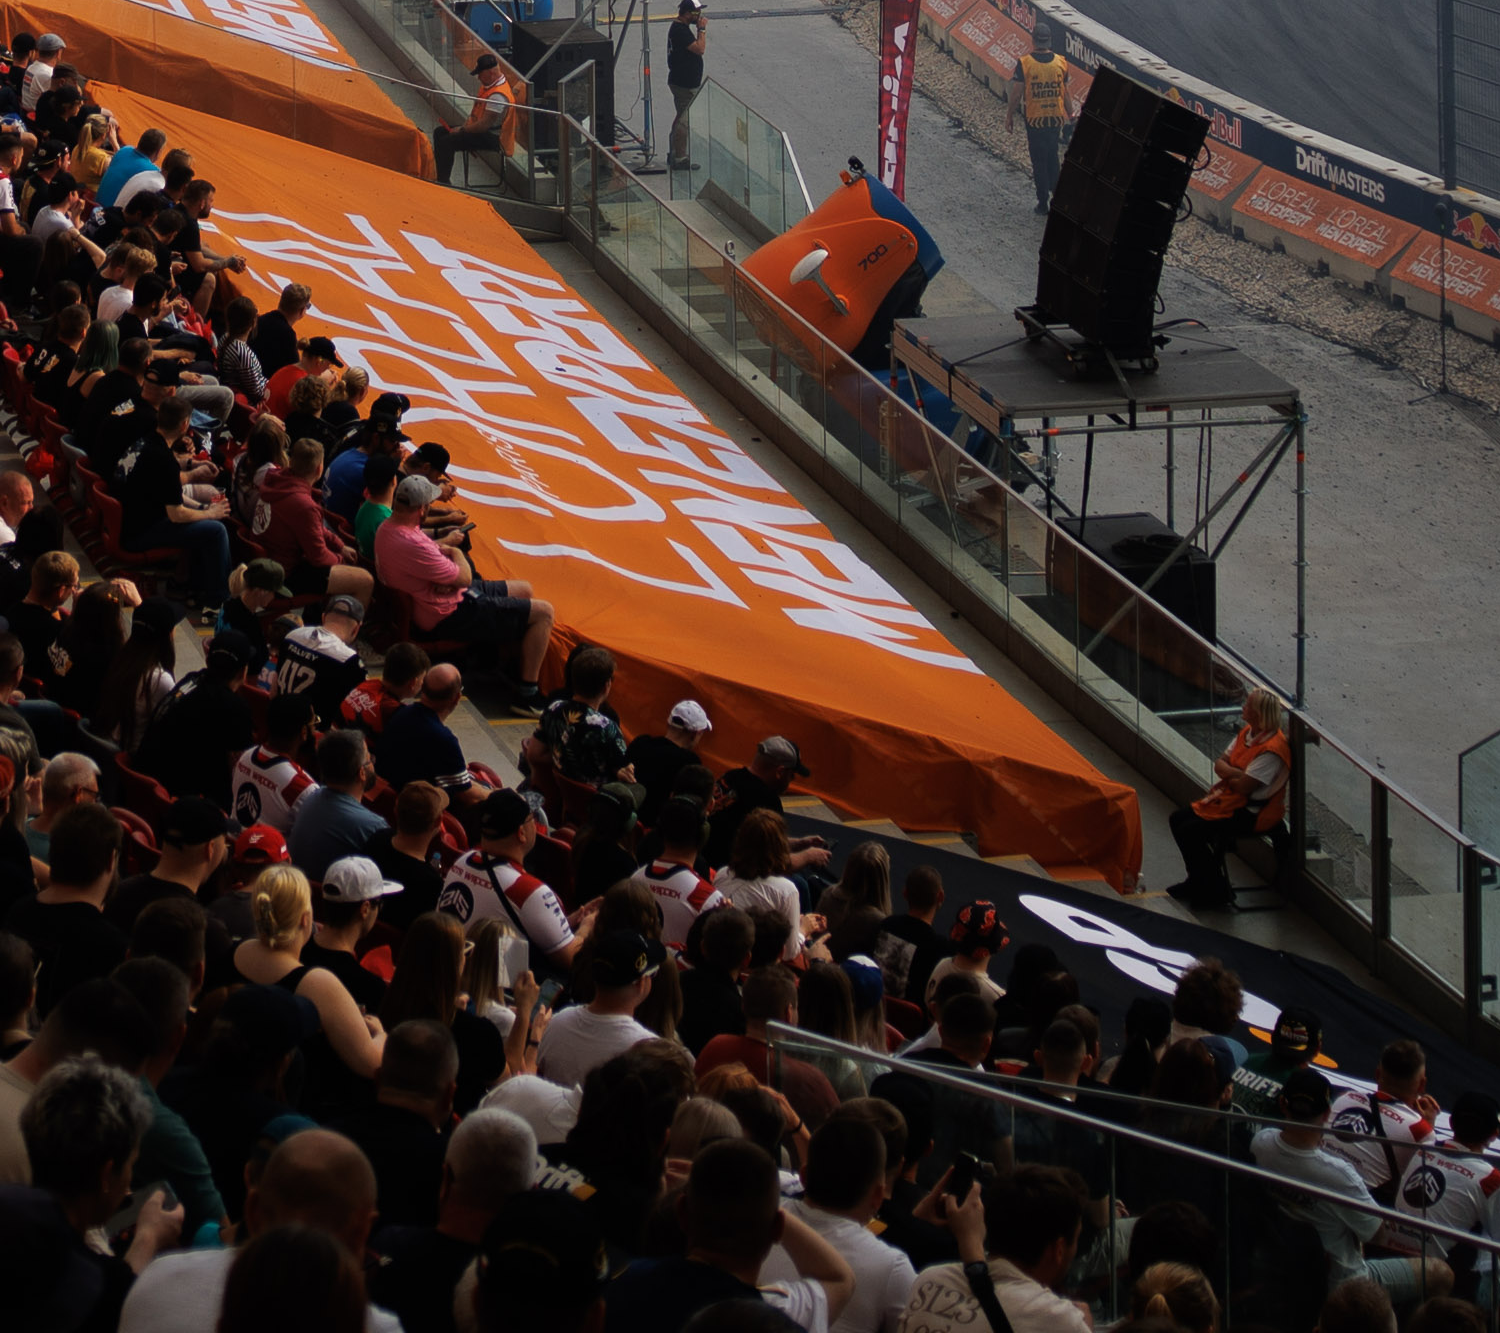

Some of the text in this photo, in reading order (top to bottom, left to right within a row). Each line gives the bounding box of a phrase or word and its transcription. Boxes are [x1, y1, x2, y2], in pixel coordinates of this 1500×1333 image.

[858, 243, 889, 272] 700
[401, 231, 984, 676] MEN EXPERT
[278, 660, 316, 694] 412
[1232, 1067, 1283, 1098] DRIFT
